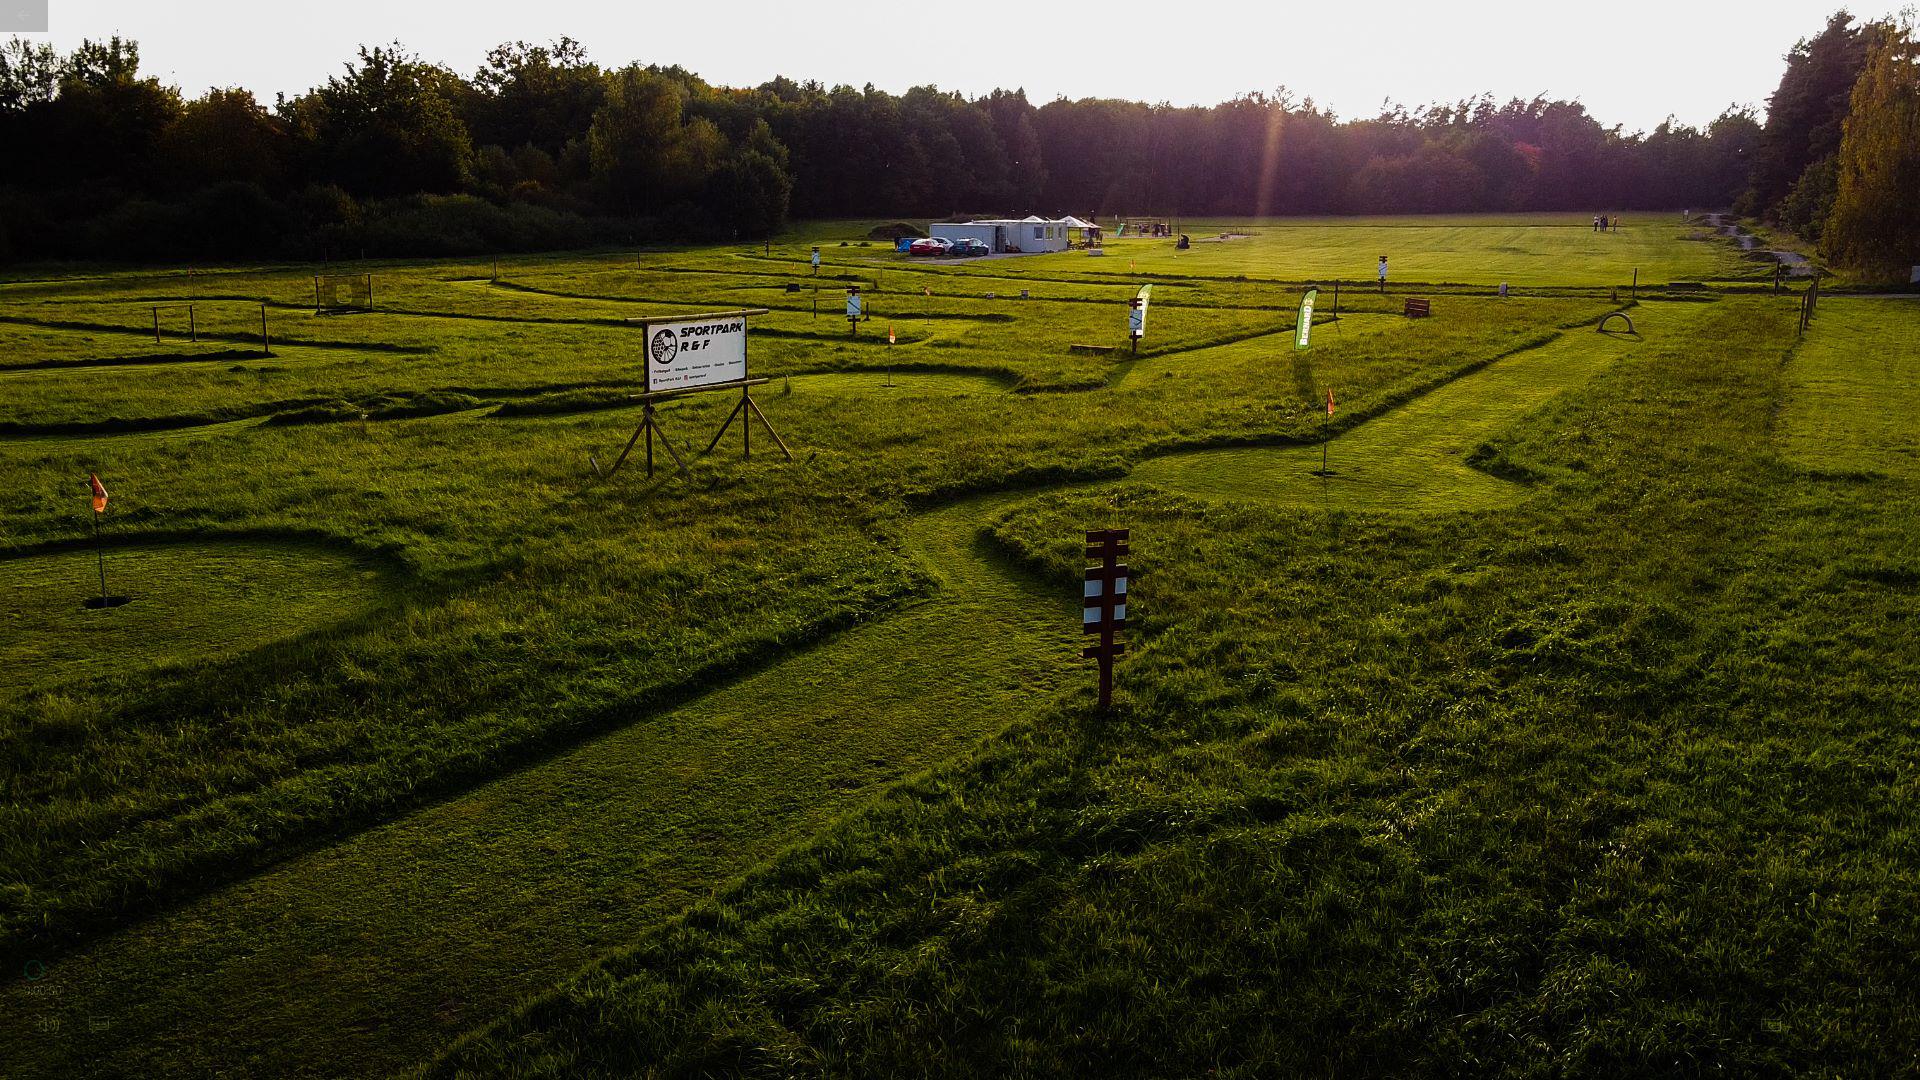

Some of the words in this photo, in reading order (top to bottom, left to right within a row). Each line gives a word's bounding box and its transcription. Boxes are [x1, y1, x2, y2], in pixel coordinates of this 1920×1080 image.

[680, 322, 743, 337] SPORTPARK
[680, 341, 688, 352] R
[691, 340, 700, 351] &
[702, 339, 711, 350] F
